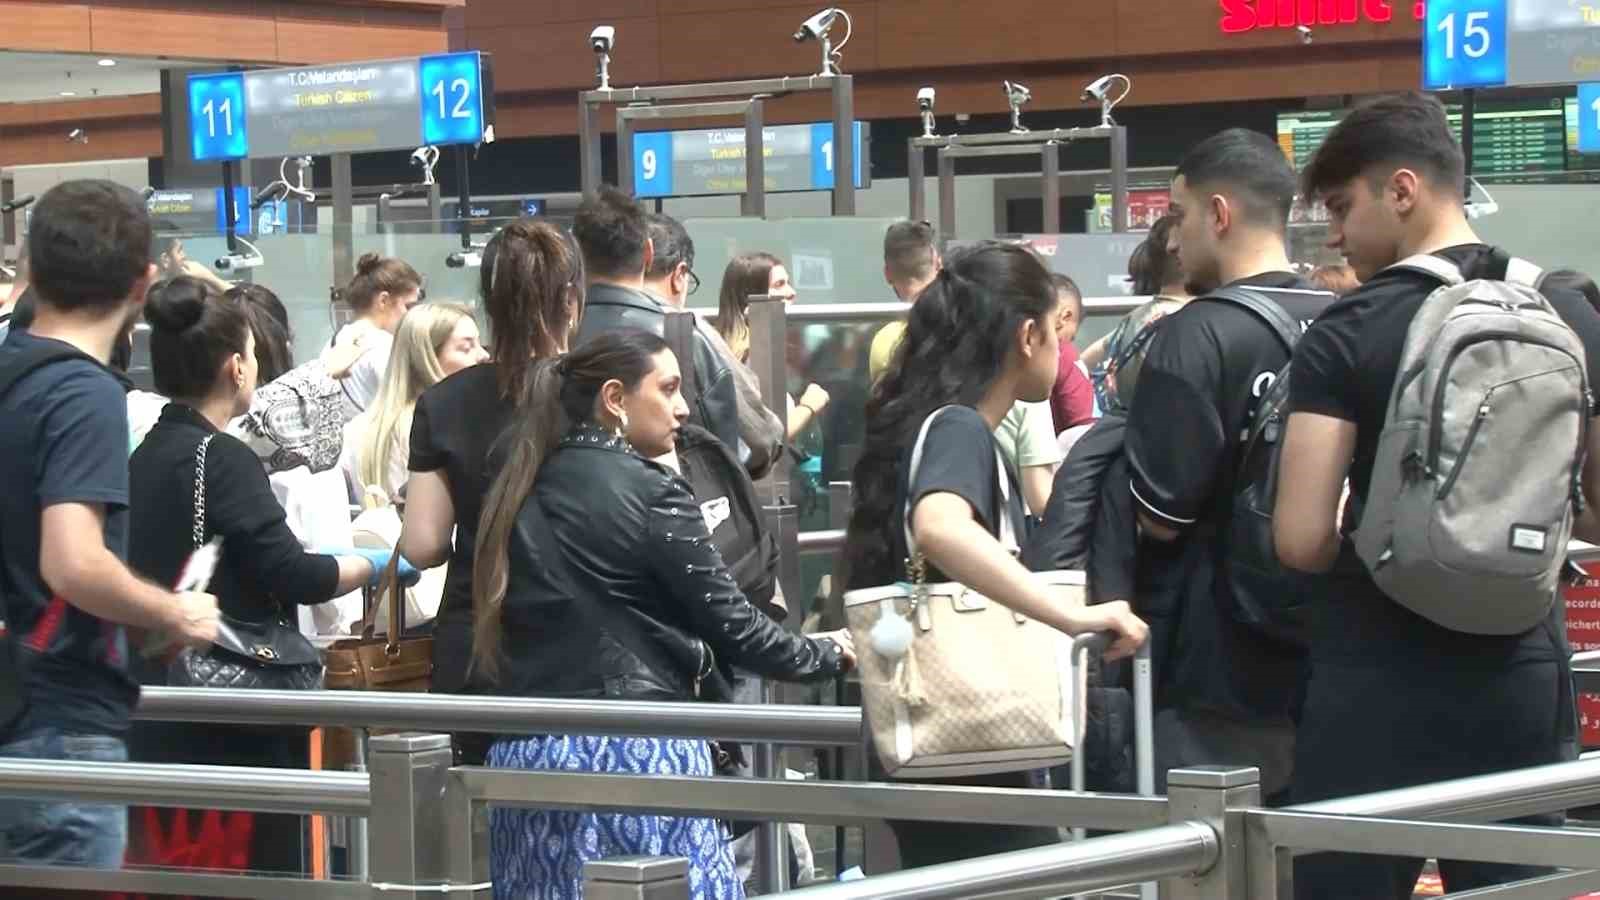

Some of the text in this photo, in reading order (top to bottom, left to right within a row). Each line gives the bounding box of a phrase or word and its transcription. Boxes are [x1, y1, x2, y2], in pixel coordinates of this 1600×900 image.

[1436, 11, 1491, 59] 15
[202, 98, 233, 137] 11
[431, 78, 472, 119] 12
[642, 149, 657, 180] 9
